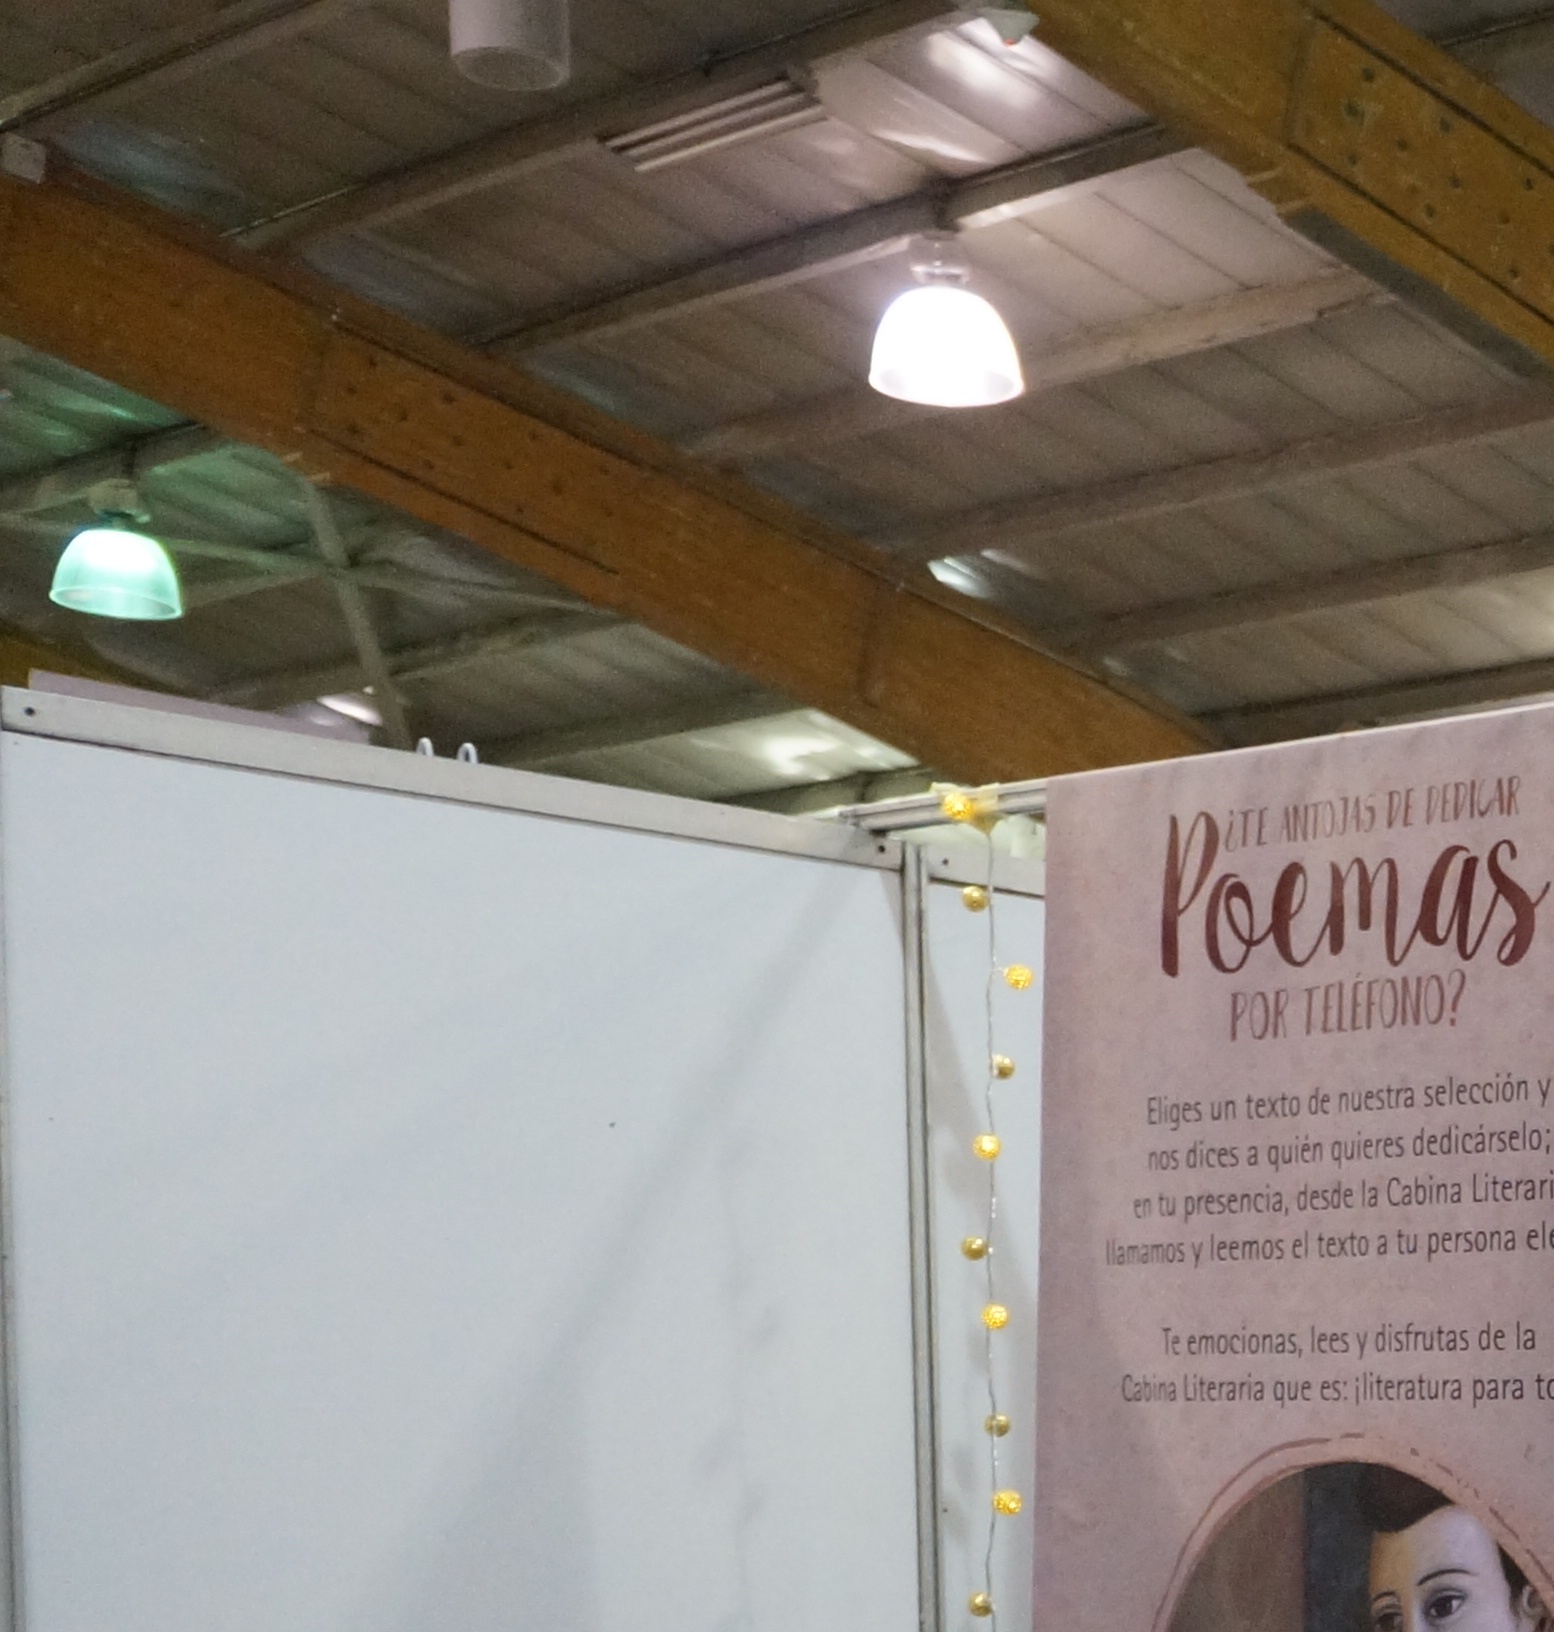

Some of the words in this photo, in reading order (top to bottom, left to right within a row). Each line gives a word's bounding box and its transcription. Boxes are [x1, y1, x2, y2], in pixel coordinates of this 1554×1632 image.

[1281, 791, 1377, 844] ANTOJAS
[1387, 786, 1414, 828] DE
[1426, 775, 1522, 824] DEDICAR
[1160, 810, 1553, 978] Poemas
[1230, 987, 1290, 1042] POR
[1303, 969, 1467, 1037] TELÉFONO?
[1146, 1095, 1202, 1132] Eliges
[1210, 1098, 1237, 1122] un
[1246, 1092, 1301, 1121] texto
[1307, 1086, 1332, 1116] de
[1338, 1083, 1416, 1113] nuestra
[1423, 1071, 1529, 1108] selección
[1537, 1076, 1552, 1108] y
[1148, 1148, 1180, 1171] nos
[1185, 1140, 1240, 1169] dices
[1246, 1144, 1259, 1167] a
[1267, 1133, 1323, 1172] quién
[1331, 1130, 1405, 1170] quieres
[1412, 1119, 1551, 1156] dedicárselo;
[1132, 1197, 1152, 1219] en
[1157, 1192, 1177, 1217] tu
[1184, 1182, 1290, 1225] presencia,
[1296, 1180, 1354, 1212] desde
[1361, 1178, 1379, 1208] la
[1386, 1174, 1463, 1208] Cabina
[1105, 1238, 1185, 1267] llamamos
[1191, 1240, 1204, 1270] y
[1209, 1233, 1285, 1263] leemos
[1291, 1229, 1309, 1260] el
[1317, 1230, 1370, 1259] texto
[1376, 1233, 1388, 1256] a
[1397, 1228, 1418, 1256] tu
[1427, 1226, 1517, 1263] persona
[1160, 1327, 1181, 1356] Te
[1186, 1325, 1303, 1359] emocionas,
[1310, 1324, 1350, 1354] lees
[1356, 1330, 1368, 1360] y
[1374, 1321, 1470, 1353] disfrutas
[1477, 1320, 1507, 1352] de
[1515, 1320, 1537, 1351] la
[1121, 1373, 1178, 1403] Cabina
[1182, 1371, 1265, 1403] Literaria
[1272, 1379, 1312, 1409] que
[1319, 1378, 1349, 1402] es:
[1355, 1371, 1463, 1407] ¡literatura
[1472, 1376, 1525, 1409] para
